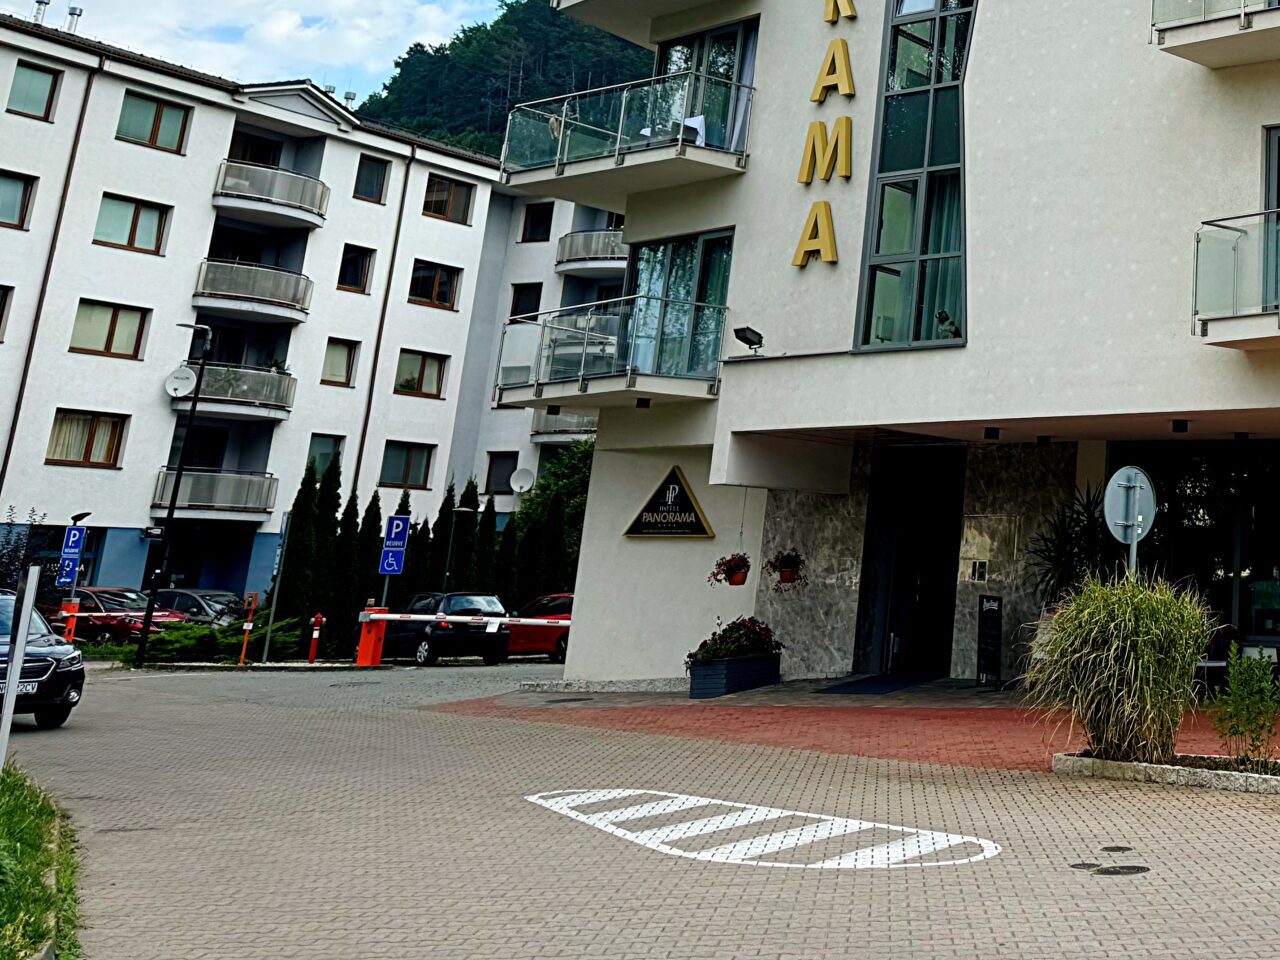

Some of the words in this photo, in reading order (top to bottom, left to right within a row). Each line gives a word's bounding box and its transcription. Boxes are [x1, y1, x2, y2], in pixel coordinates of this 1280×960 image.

[642, 512, 696, 522] PANORAMA
[391, 520, 403, 538] P
[69, 530, 79, 546] P
